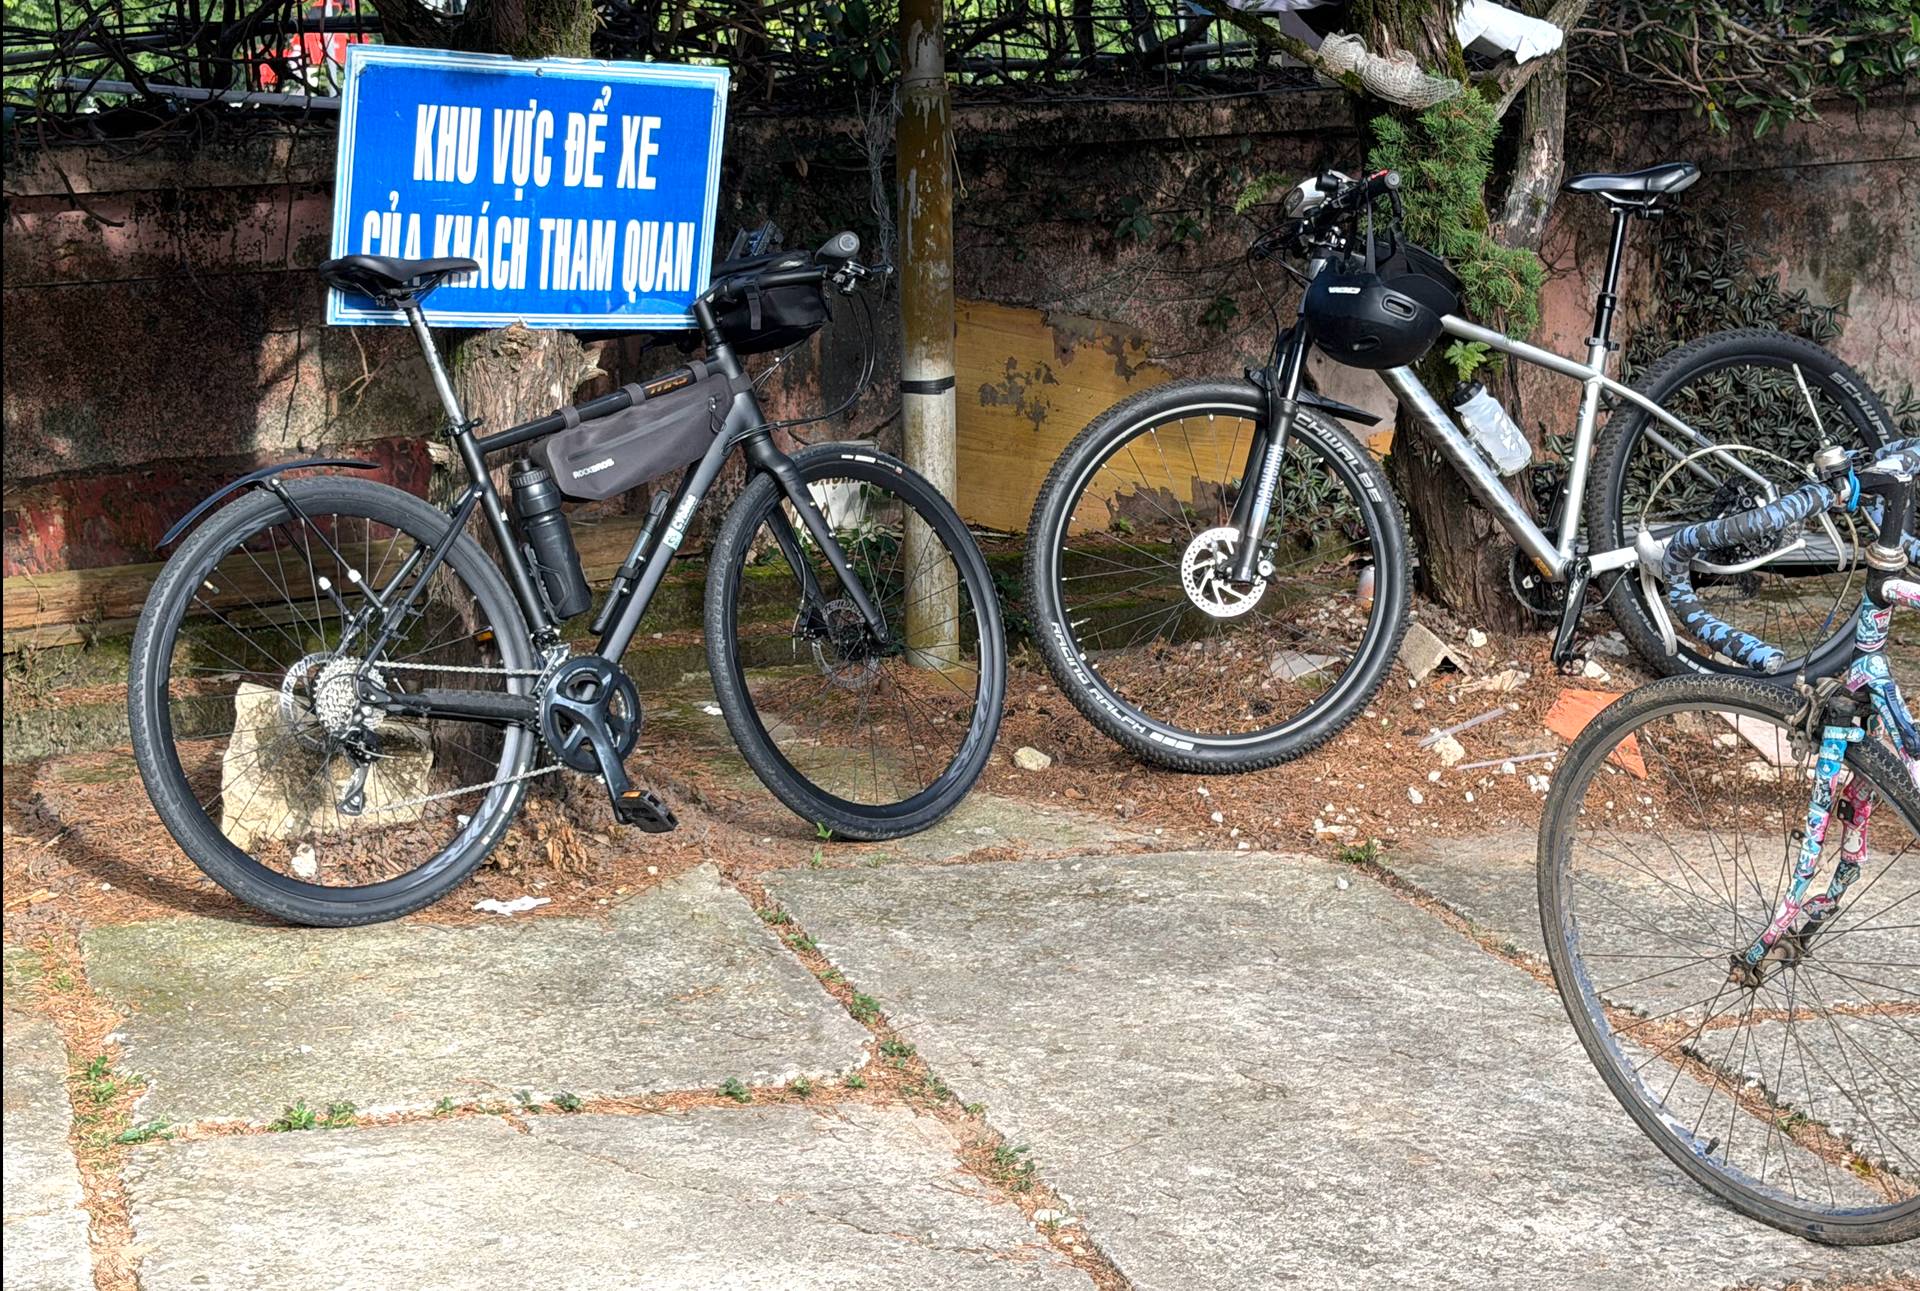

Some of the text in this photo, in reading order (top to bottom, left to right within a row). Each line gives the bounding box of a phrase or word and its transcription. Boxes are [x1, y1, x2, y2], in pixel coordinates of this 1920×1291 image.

[413, 86, 661, 201] KHU VỰC ĐỂ XE
[433, 201, 530, 291] KHÁCH
[539, 218, 617, 291] THAM
[622, 218, 695, 303] QUAN
[1295, 412, 1383, 503] CHWALBE
[1829, 372, 1890, 447] SCHWAL
[1051, 622, 1147, 733] RACING RALPH
